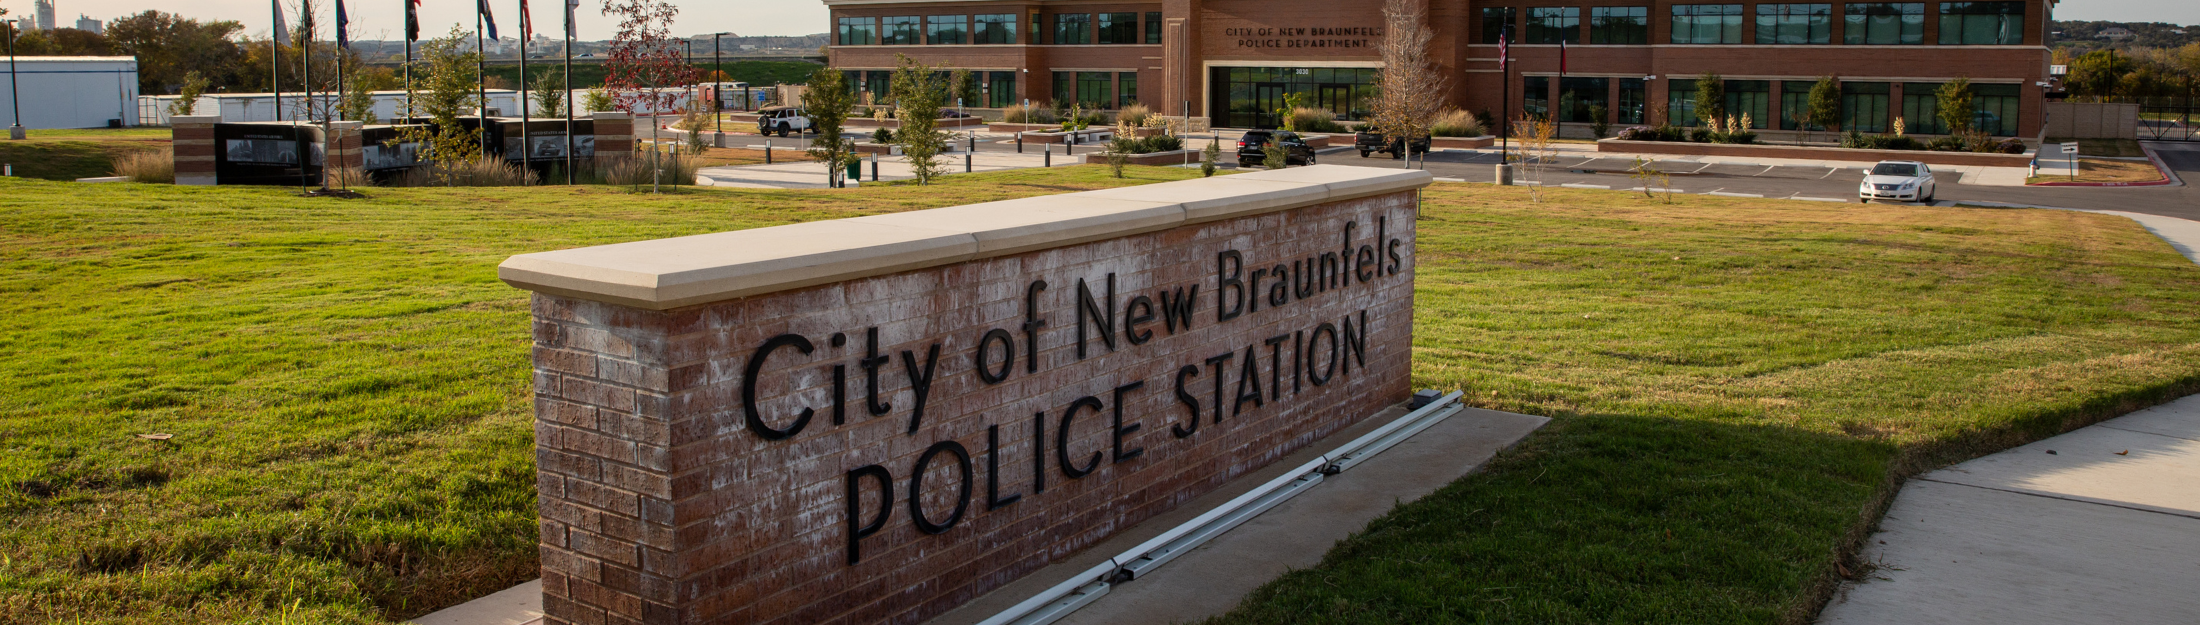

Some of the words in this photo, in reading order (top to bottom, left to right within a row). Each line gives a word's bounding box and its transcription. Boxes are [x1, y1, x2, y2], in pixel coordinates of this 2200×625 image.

[1225, 27, 1252, 36] CITY
[1258, 27, 1274, 36] OF
[1279, 27, 1306, 36] NEW
[1238, 39, 1281, 48] POLICE
[1287, 39, 1368, 48] DEPARTMENT
[743, 326, 941, 441] City
[977, 279, 1048, 385] of
[1078, 272, 1200, 360] New
[1217, 215, 1401, 323] Braunfels
[847, 380, 1145, 567] POLICE
[1173, 309, 1368, 439] STATION
